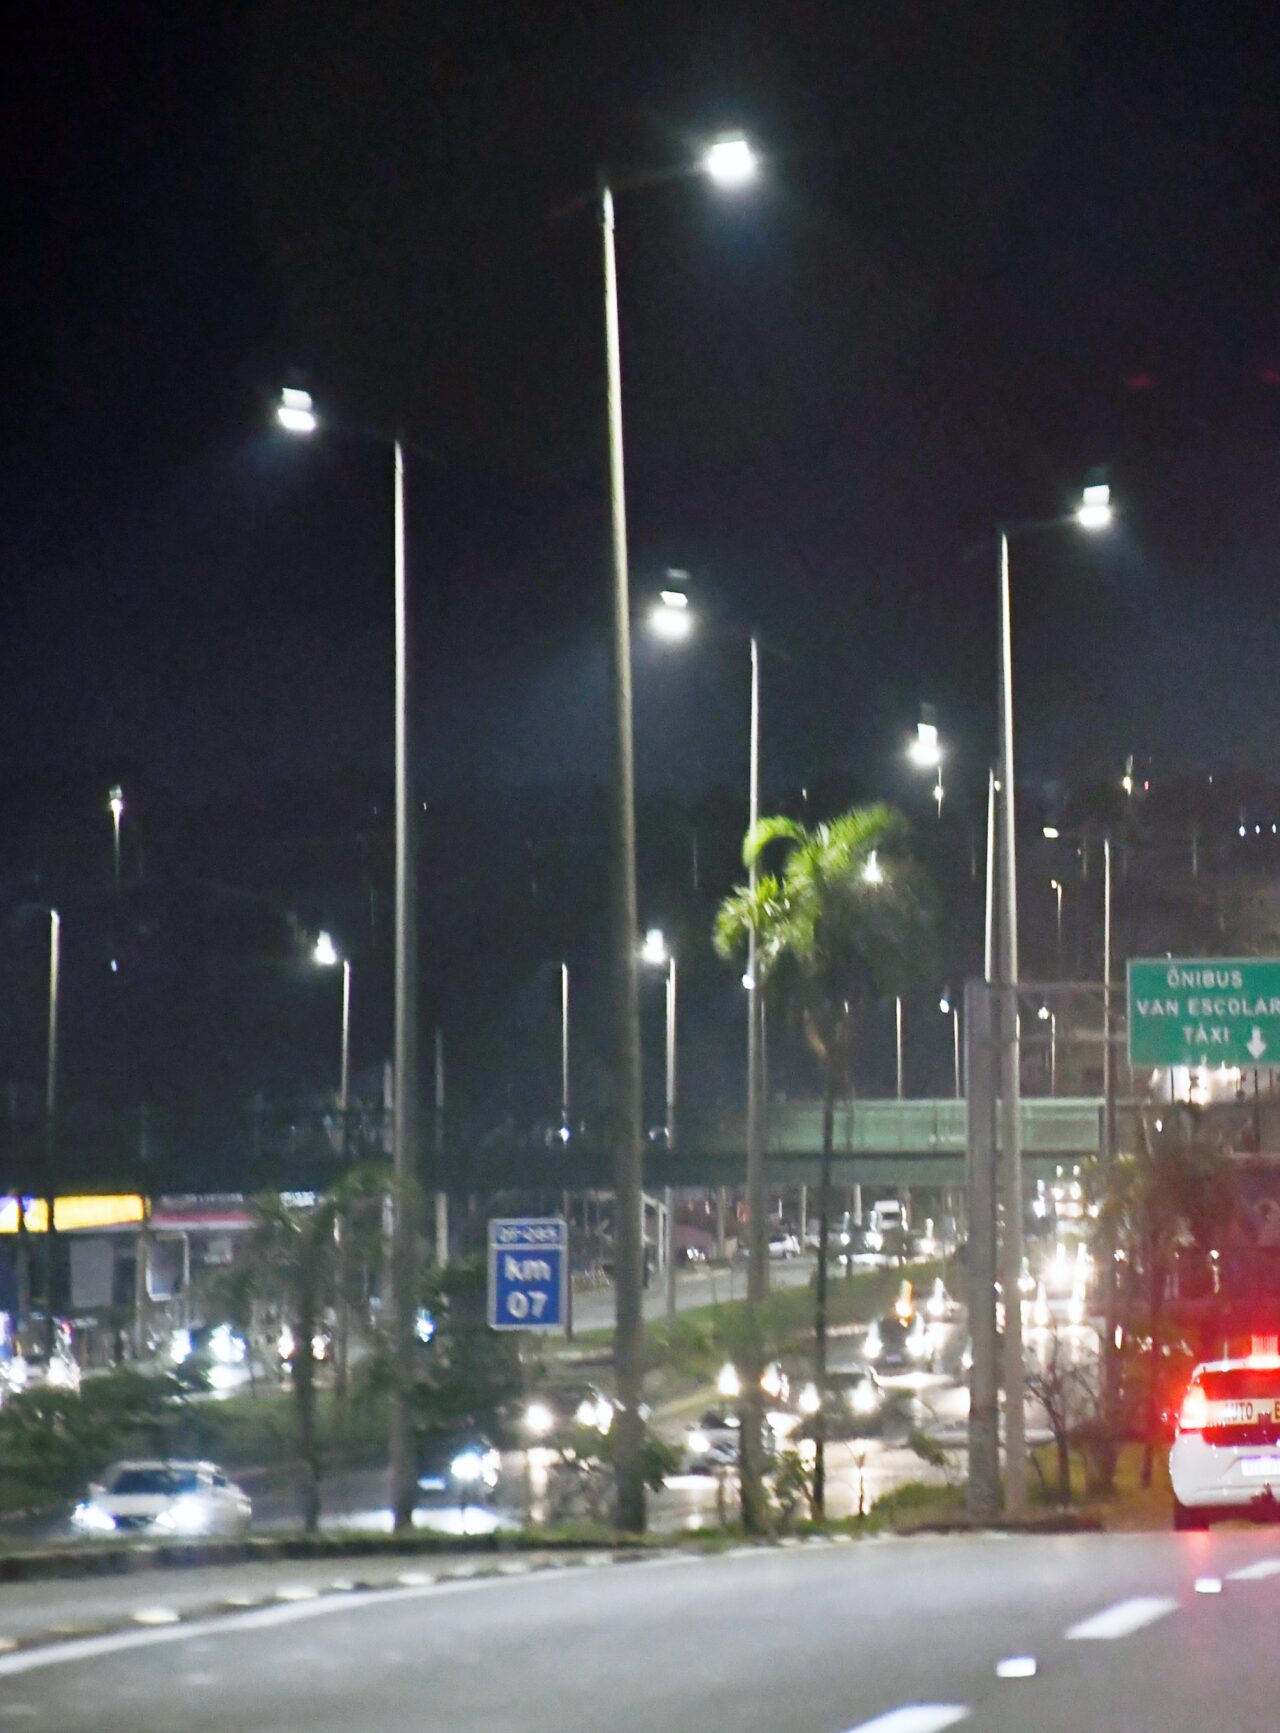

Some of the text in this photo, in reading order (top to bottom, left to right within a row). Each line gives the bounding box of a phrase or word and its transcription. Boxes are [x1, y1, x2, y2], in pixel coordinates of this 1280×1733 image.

[1167, 966, 1243, 989] ÔNIBUS
[1136, 999, 1179, 1016] VAN
[504, 1254, 552, 1281] km
[507, 1291, 548, 1319] 07
